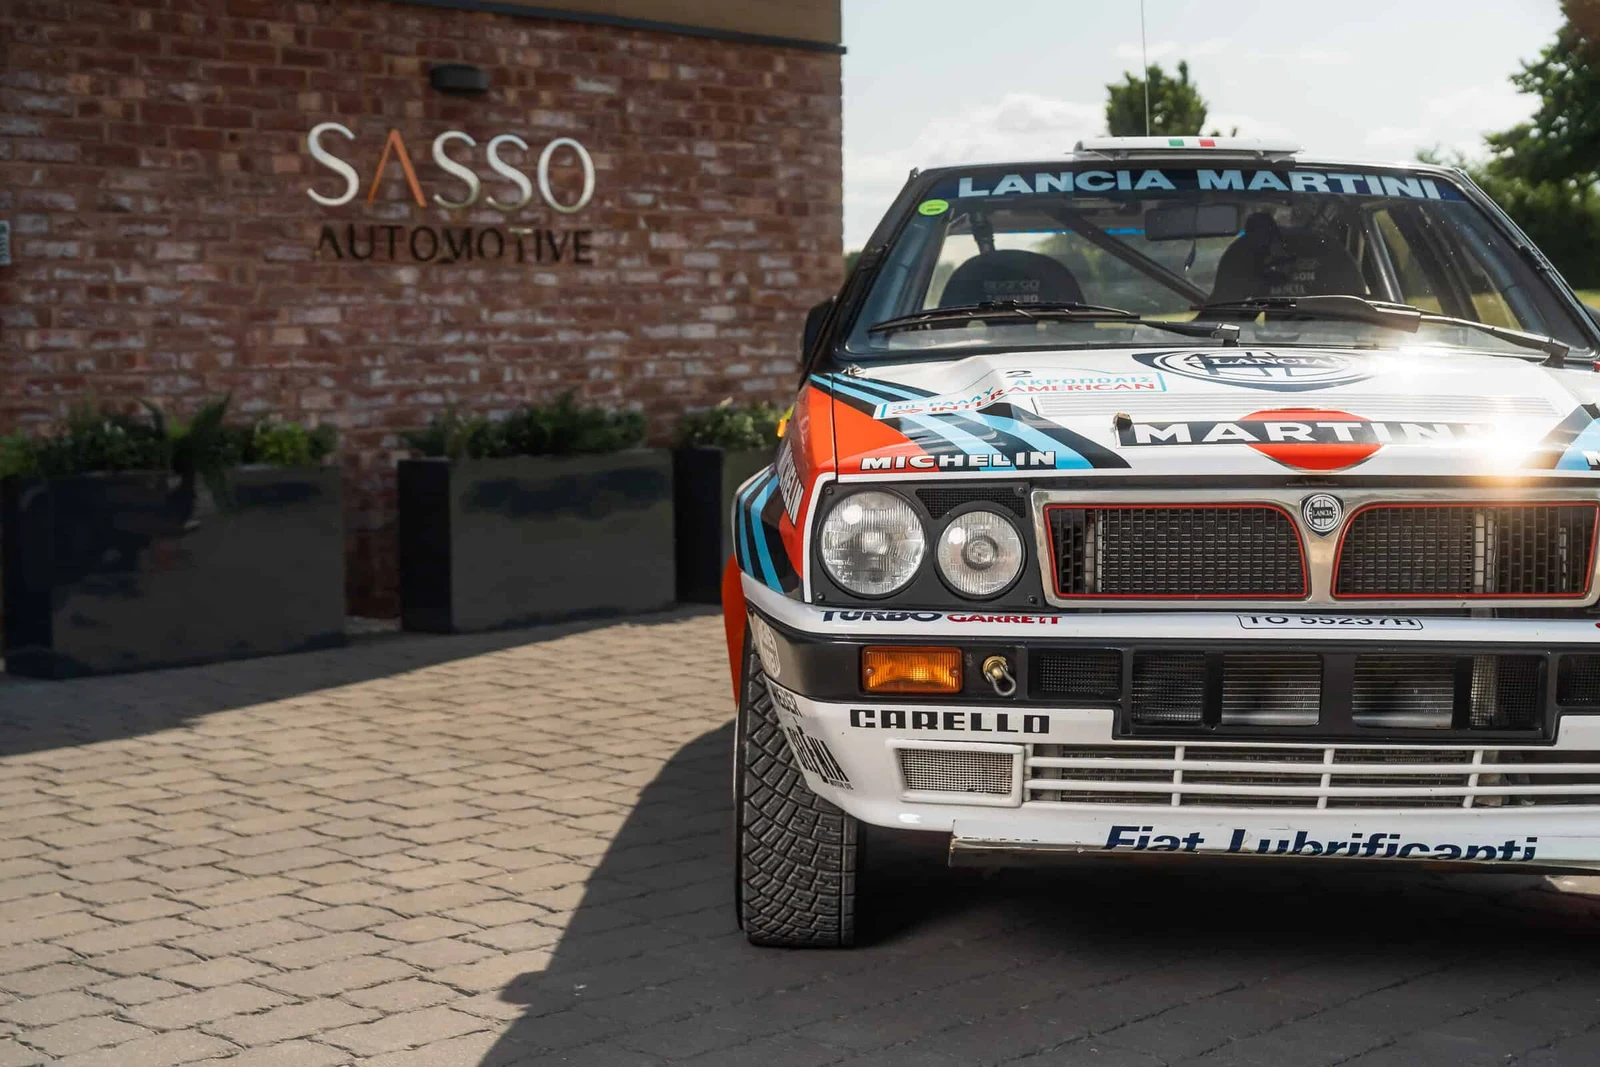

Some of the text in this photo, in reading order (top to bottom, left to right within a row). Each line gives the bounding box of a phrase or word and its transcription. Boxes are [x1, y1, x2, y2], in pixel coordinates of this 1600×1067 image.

[306, 122, 595, 213] SASSO
[958, 169, 1441, 199] LANCIA MARTINI
[315, 224, 594, 264] AUTOMOTIVE
[860, 451, 1057, 471] MICHELIN
[820, 610, 1062, 624] TURBO GARRETT
[850, 709, 1049, 734] CARELLO
[1103, 825, 1538, 861] Fiat Lubrificanti
